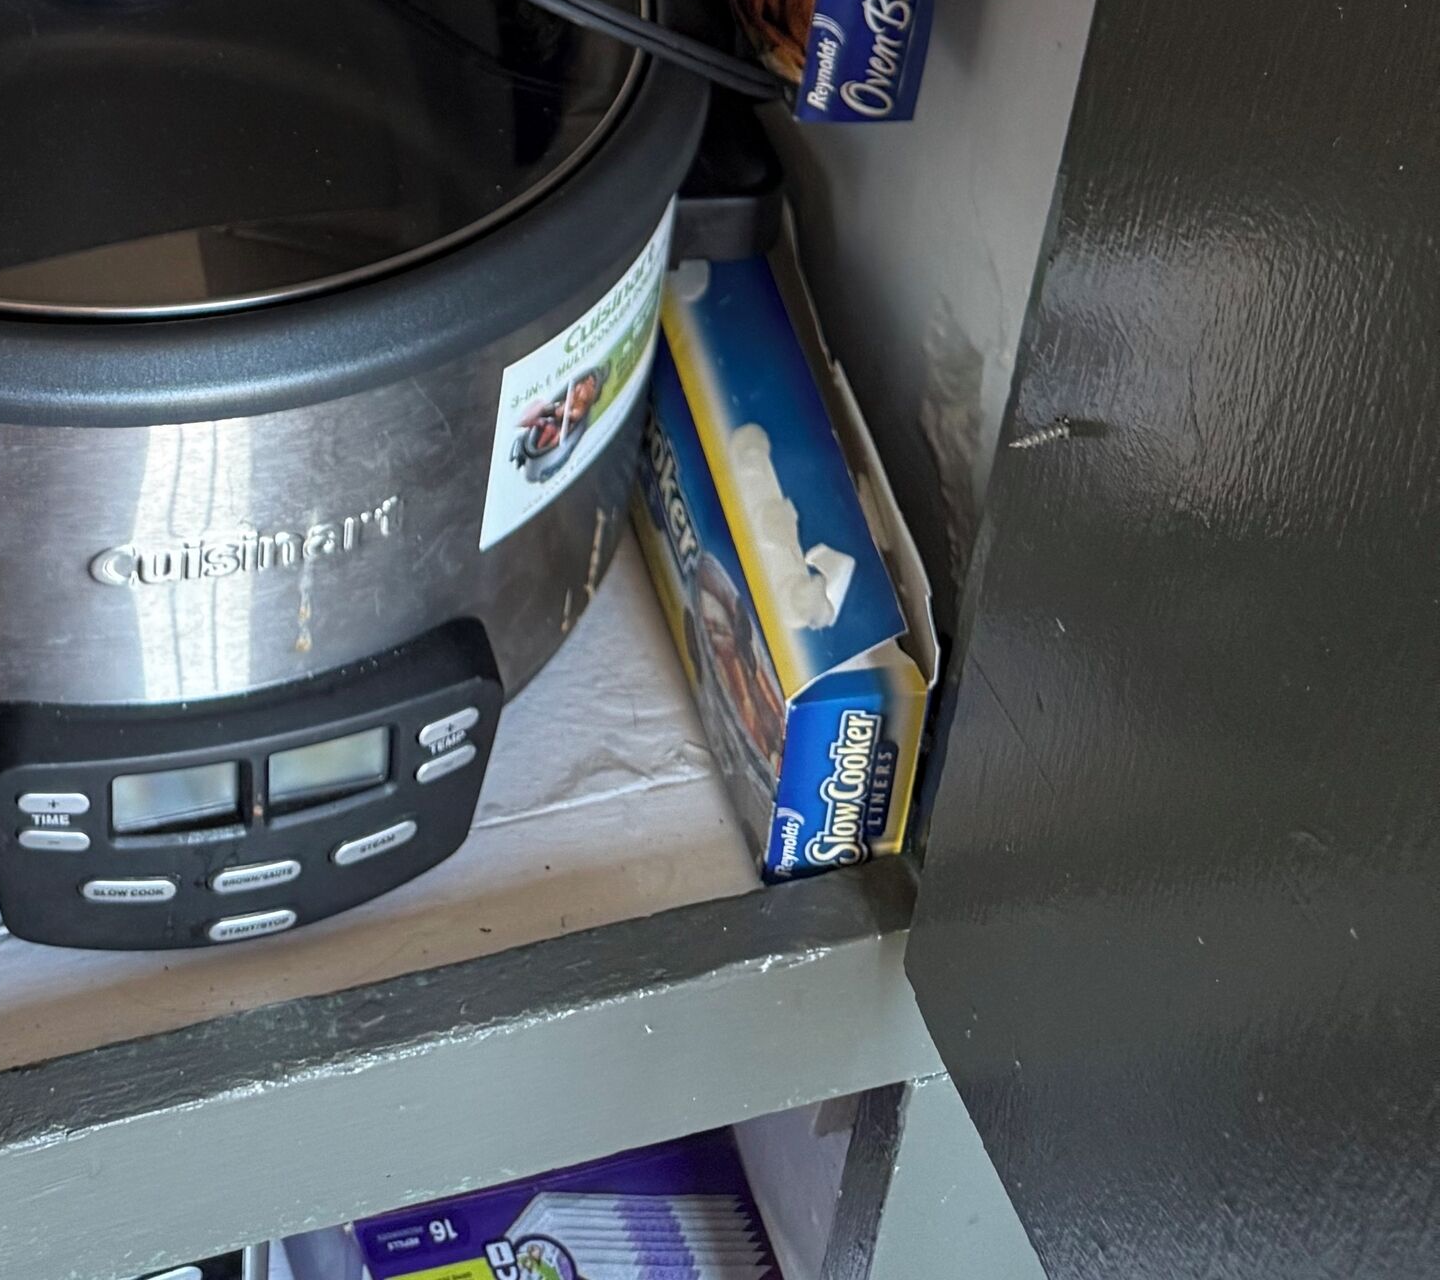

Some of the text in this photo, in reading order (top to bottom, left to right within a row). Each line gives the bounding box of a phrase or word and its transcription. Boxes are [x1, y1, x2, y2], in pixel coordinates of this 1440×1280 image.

[807, 37, 839, 112] Reynolds
[840, 32, 902, 118] Oven
[31, 813, 70, 826] TIME
[811, 714, 876, 865] Slow Cooker
[867, 751, 893, 827] LINERS
[775, 820, 800, 876] Reynolds
[429, 1218, 458, 1243] 16
